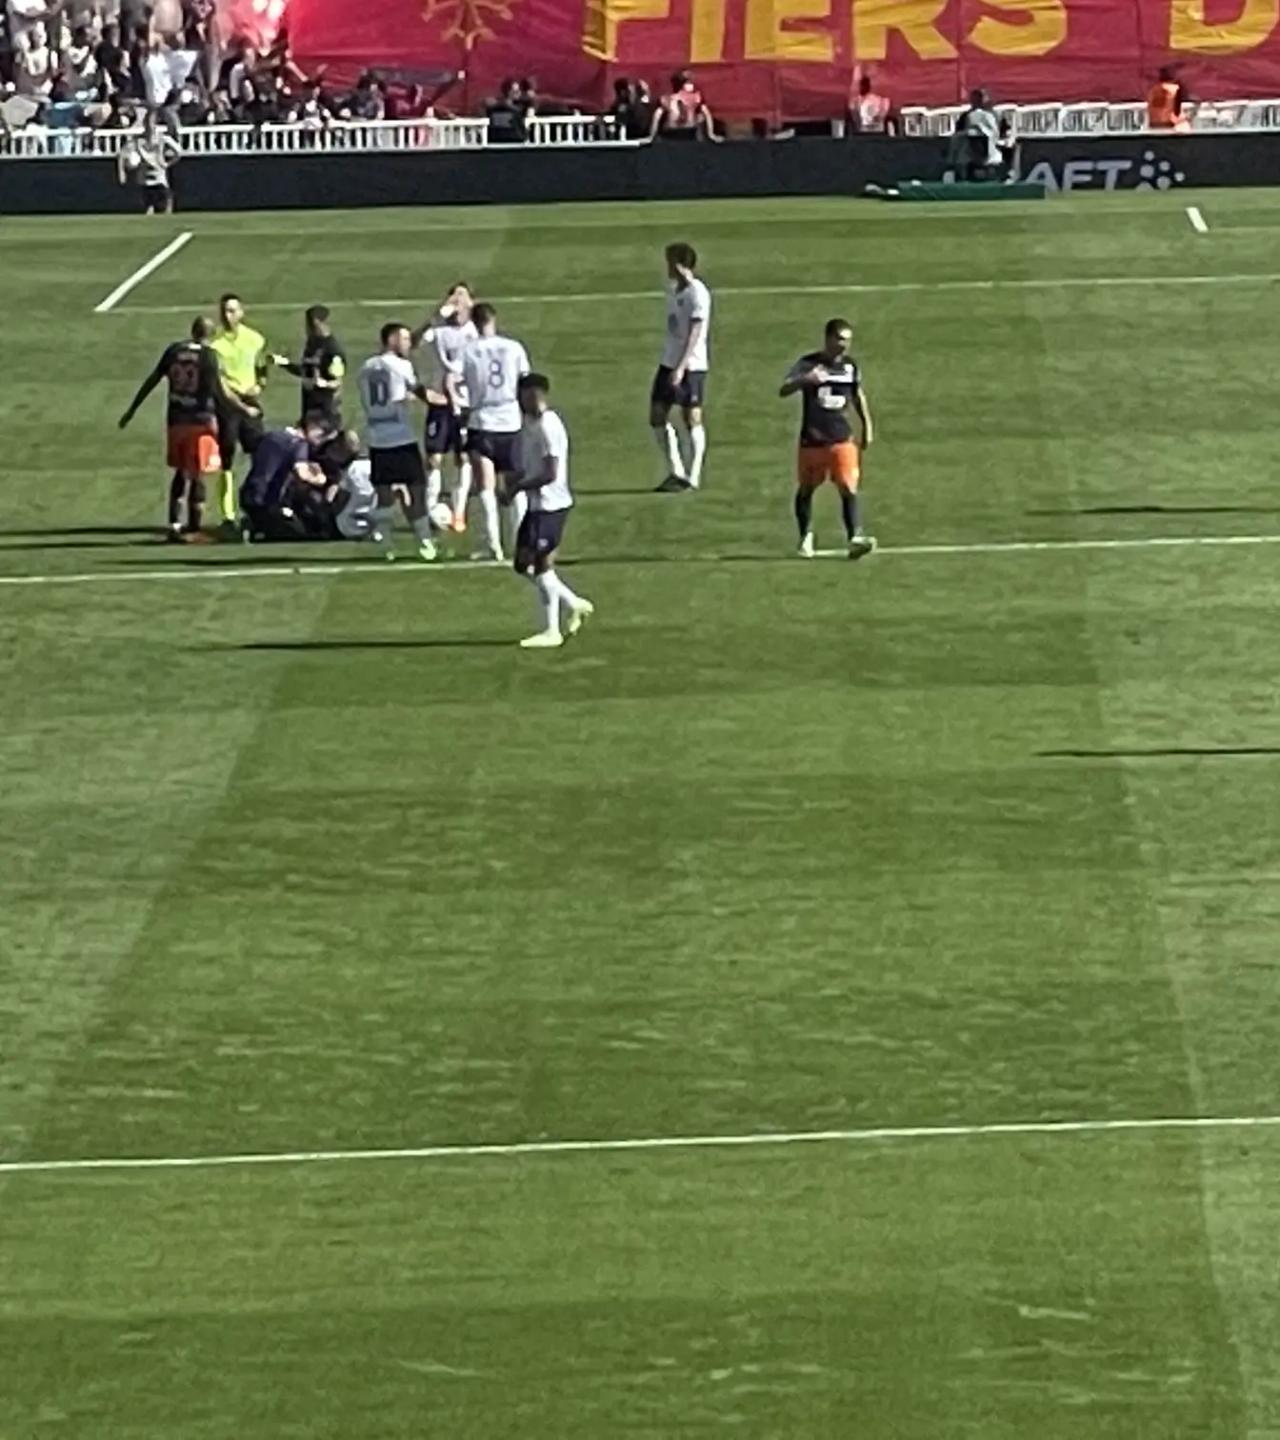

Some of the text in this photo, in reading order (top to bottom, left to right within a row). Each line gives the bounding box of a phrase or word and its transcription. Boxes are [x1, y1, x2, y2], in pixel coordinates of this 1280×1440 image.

[1025, 159, 1133, 192] AFT
[367, 366, 391, 407] 10
[488, 359, 506, 390] 8
